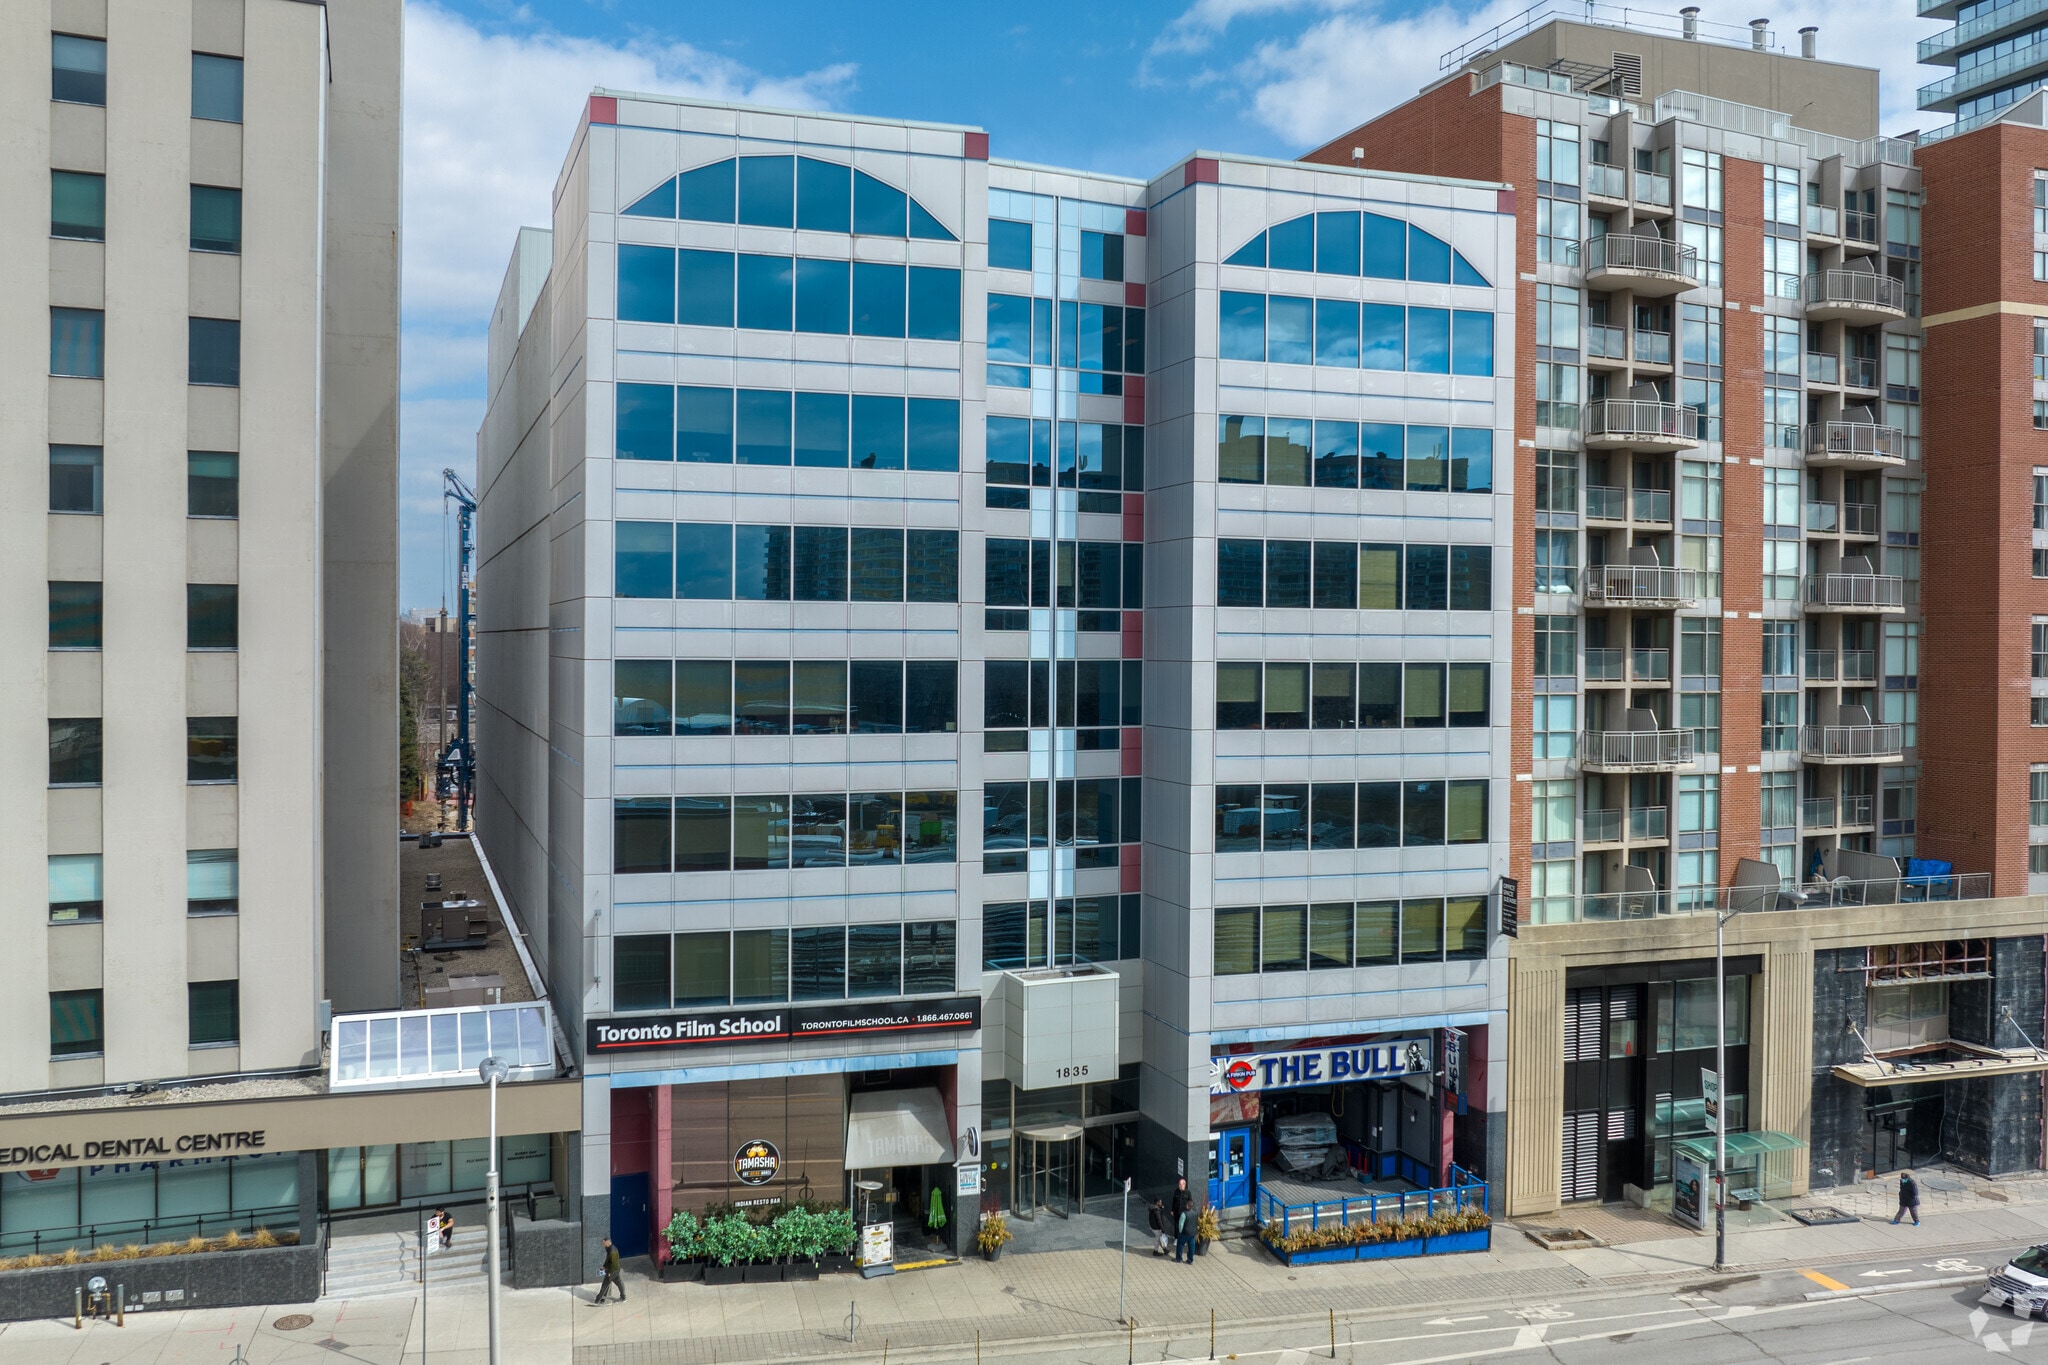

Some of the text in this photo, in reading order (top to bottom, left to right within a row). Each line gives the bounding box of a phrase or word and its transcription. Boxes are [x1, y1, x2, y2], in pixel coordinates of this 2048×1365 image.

[597, 1015, 781, 1042] Toronto Film School
[801, 1011, 972, 1030] TORONTOFILMSCHOOL.CA 1.866.467.0661
[1056, 1064, 1089, 1079] 1835
[1259, 1046, 1406, 1085] THE BULL
[84, 1137, 171, 1159] DENTAL
[175, 1130, 265, 1152] CENTRE
[738, 1156, 775, 1170] TAMASHA
